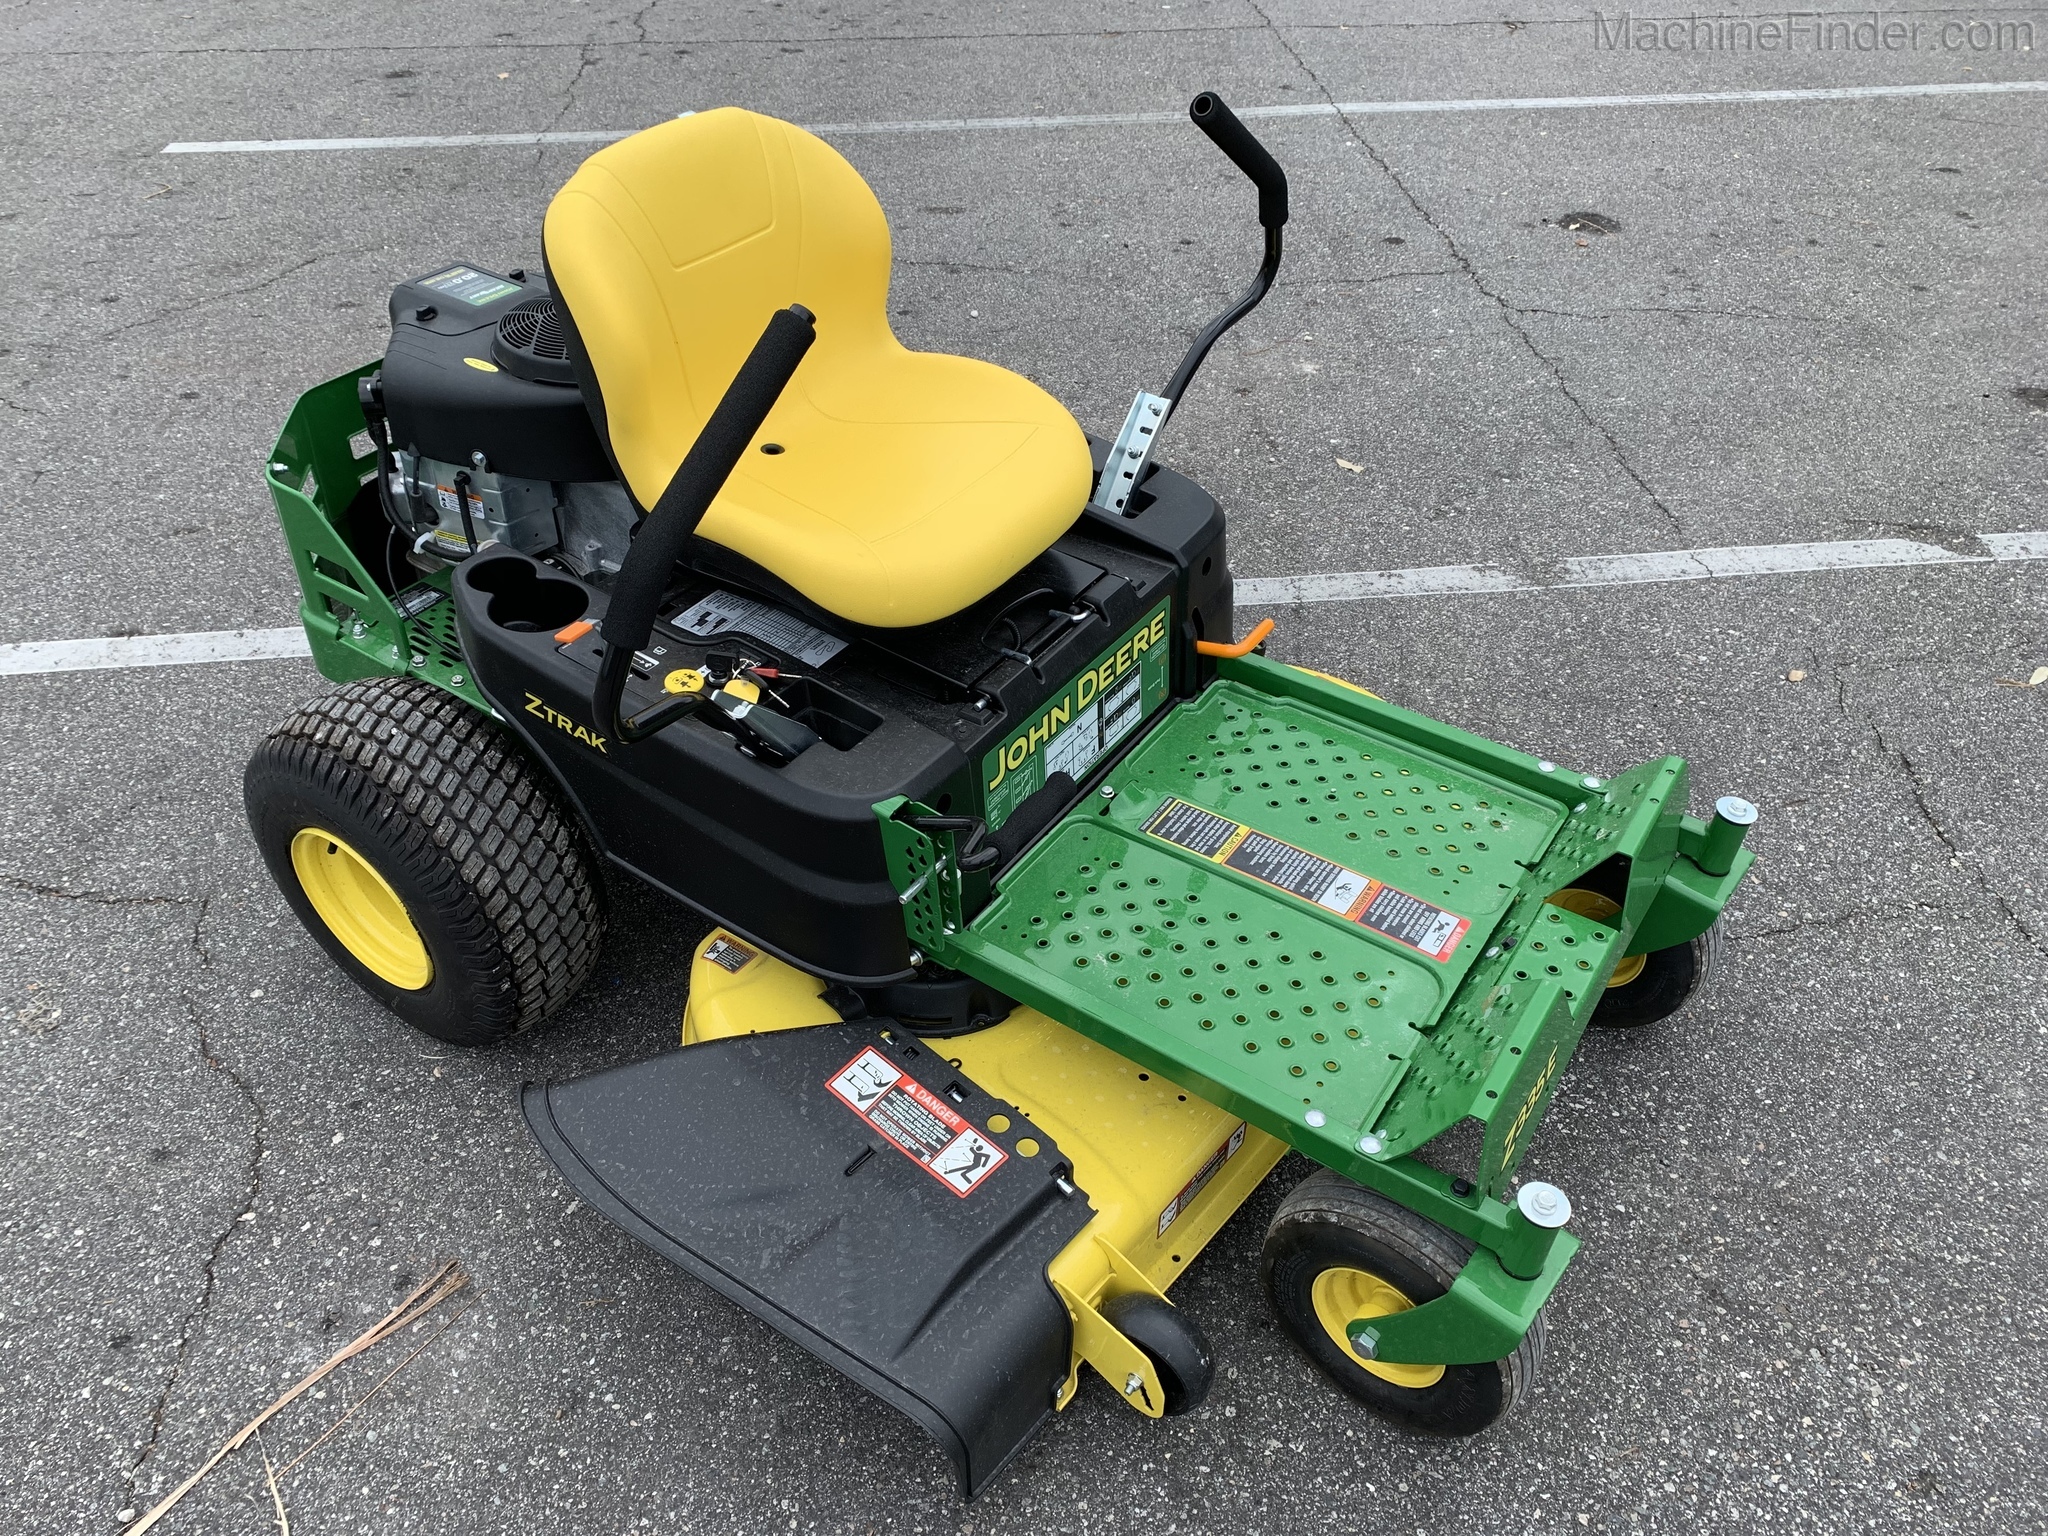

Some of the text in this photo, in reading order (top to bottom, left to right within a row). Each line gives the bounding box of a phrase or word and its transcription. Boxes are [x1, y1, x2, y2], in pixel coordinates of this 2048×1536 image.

[989, 694, 1071, 791] JOHN
[1077, 610, 1166, 711] DEERE
[1218, 836, 1239, 857] CAUTION
[1349, 890, 1372, 915] WARNING
[726, 937, 755, 957] WARNING
[1442, 931, 1461, 954] DANGER
[891, 1103, 937, 1139] THROWN OBJECTS
[902, 1094, 946, 1128] ROTATING BLADE
[915, 1089, 961, 1126] DANGER
[1500, 1044, 1558, 1173] Z335E
